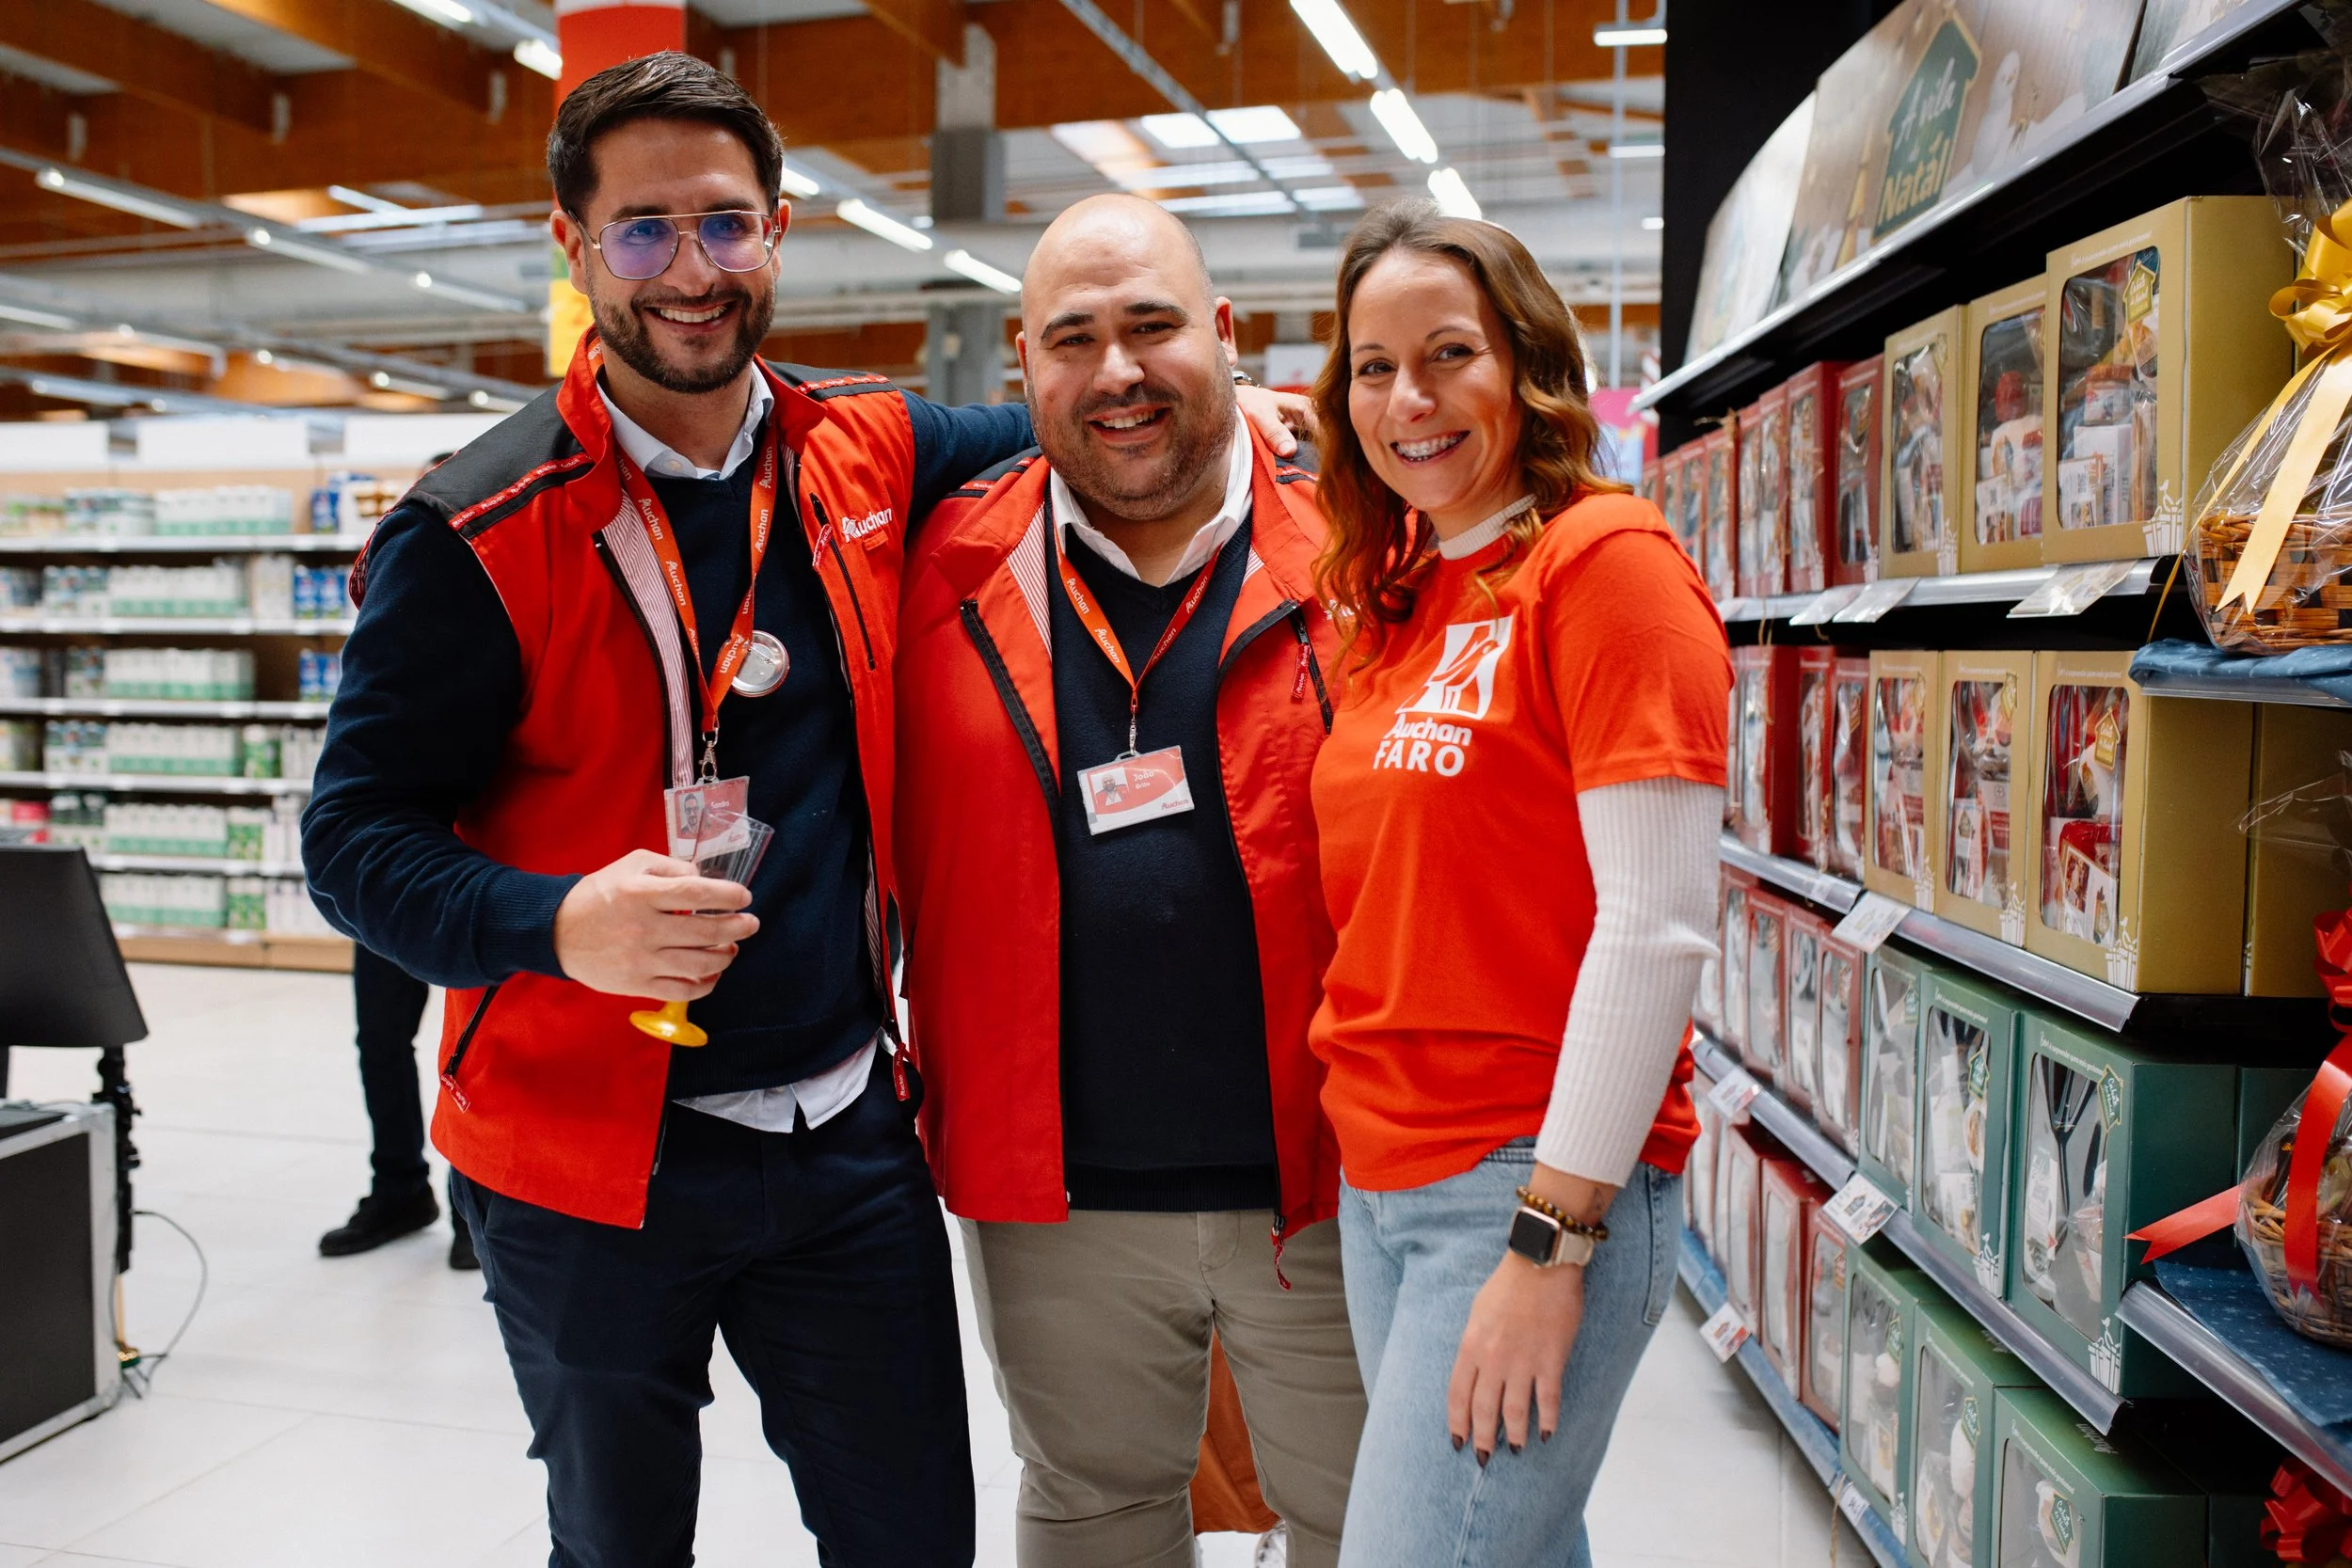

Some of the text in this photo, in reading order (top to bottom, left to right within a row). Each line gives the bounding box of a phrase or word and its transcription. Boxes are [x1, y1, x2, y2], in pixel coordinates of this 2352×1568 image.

[758, 446, 773, 489] Auchan
[637, 498, 663, 542] Auchan
[755, 508, 769, 553] Auchan
[840, 507, 893, 543] Auchan
[665, 560, 687, 607] Auchan
[1066, 577, 1090, 616] Auchan
[1185, 575, 1209, 614] Auchan
[720, 633, 745, 673] Auchan
[1093, 627, 1121, 664] Auchan
[1384, 712, 1472, 747] Auchan
[1133, 769, 1155, 782] João
[1372, 739, 1465, 777] FARO
[1161, 798, 1189, 811] Auchan
